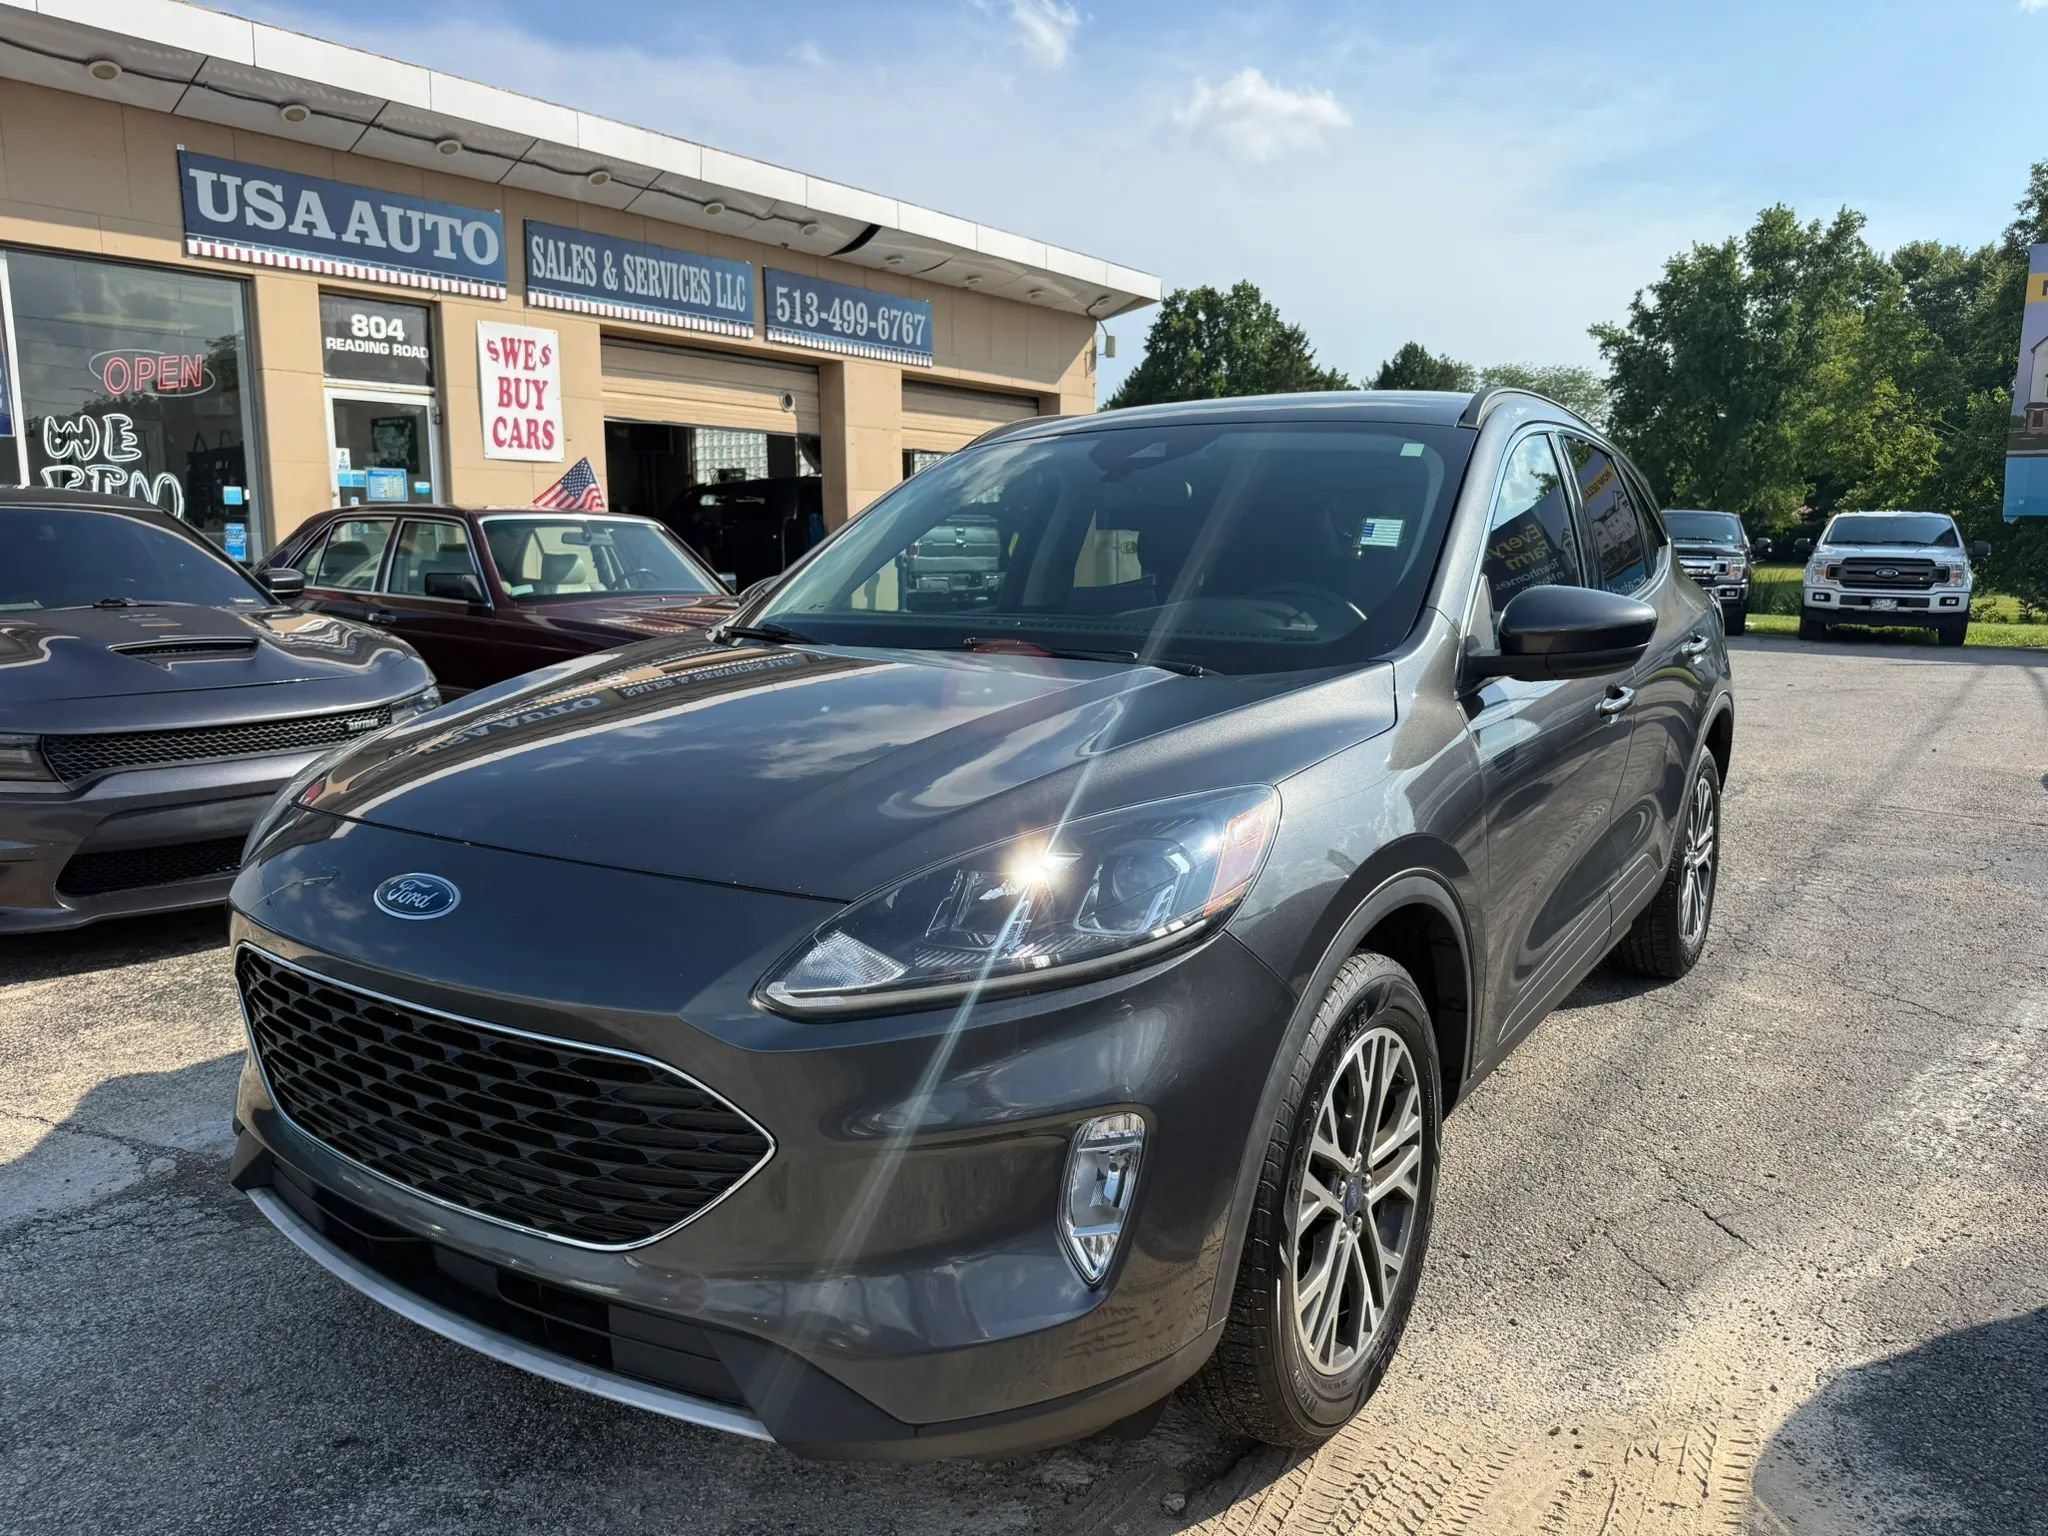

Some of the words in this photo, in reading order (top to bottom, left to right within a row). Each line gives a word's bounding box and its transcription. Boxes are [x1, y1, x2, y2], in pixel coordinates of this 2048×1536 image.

[189, 168, 336, 240] USA
[341, 199, 499, 266] AUTO
[532, 235, 597, 287] SALES
[603, 249, 619, 291] &
[623, 253, 711, 306] SERVICES
[715, 271, 746, 312] LLC
[351, 313, 405, 341] 804
[776, 285, 925, 345] 513-499-6767
[325, 336, 390, 355] READING
[392, 343, 429, 359] ROAD
[103, 354, 203, 395] OPEN
[498, 376, 549, 411] BUY
[43, 413, 142, 462] WE
[492, 416, 555, 451] CARS
[386, 879, 440, 909] Ford
